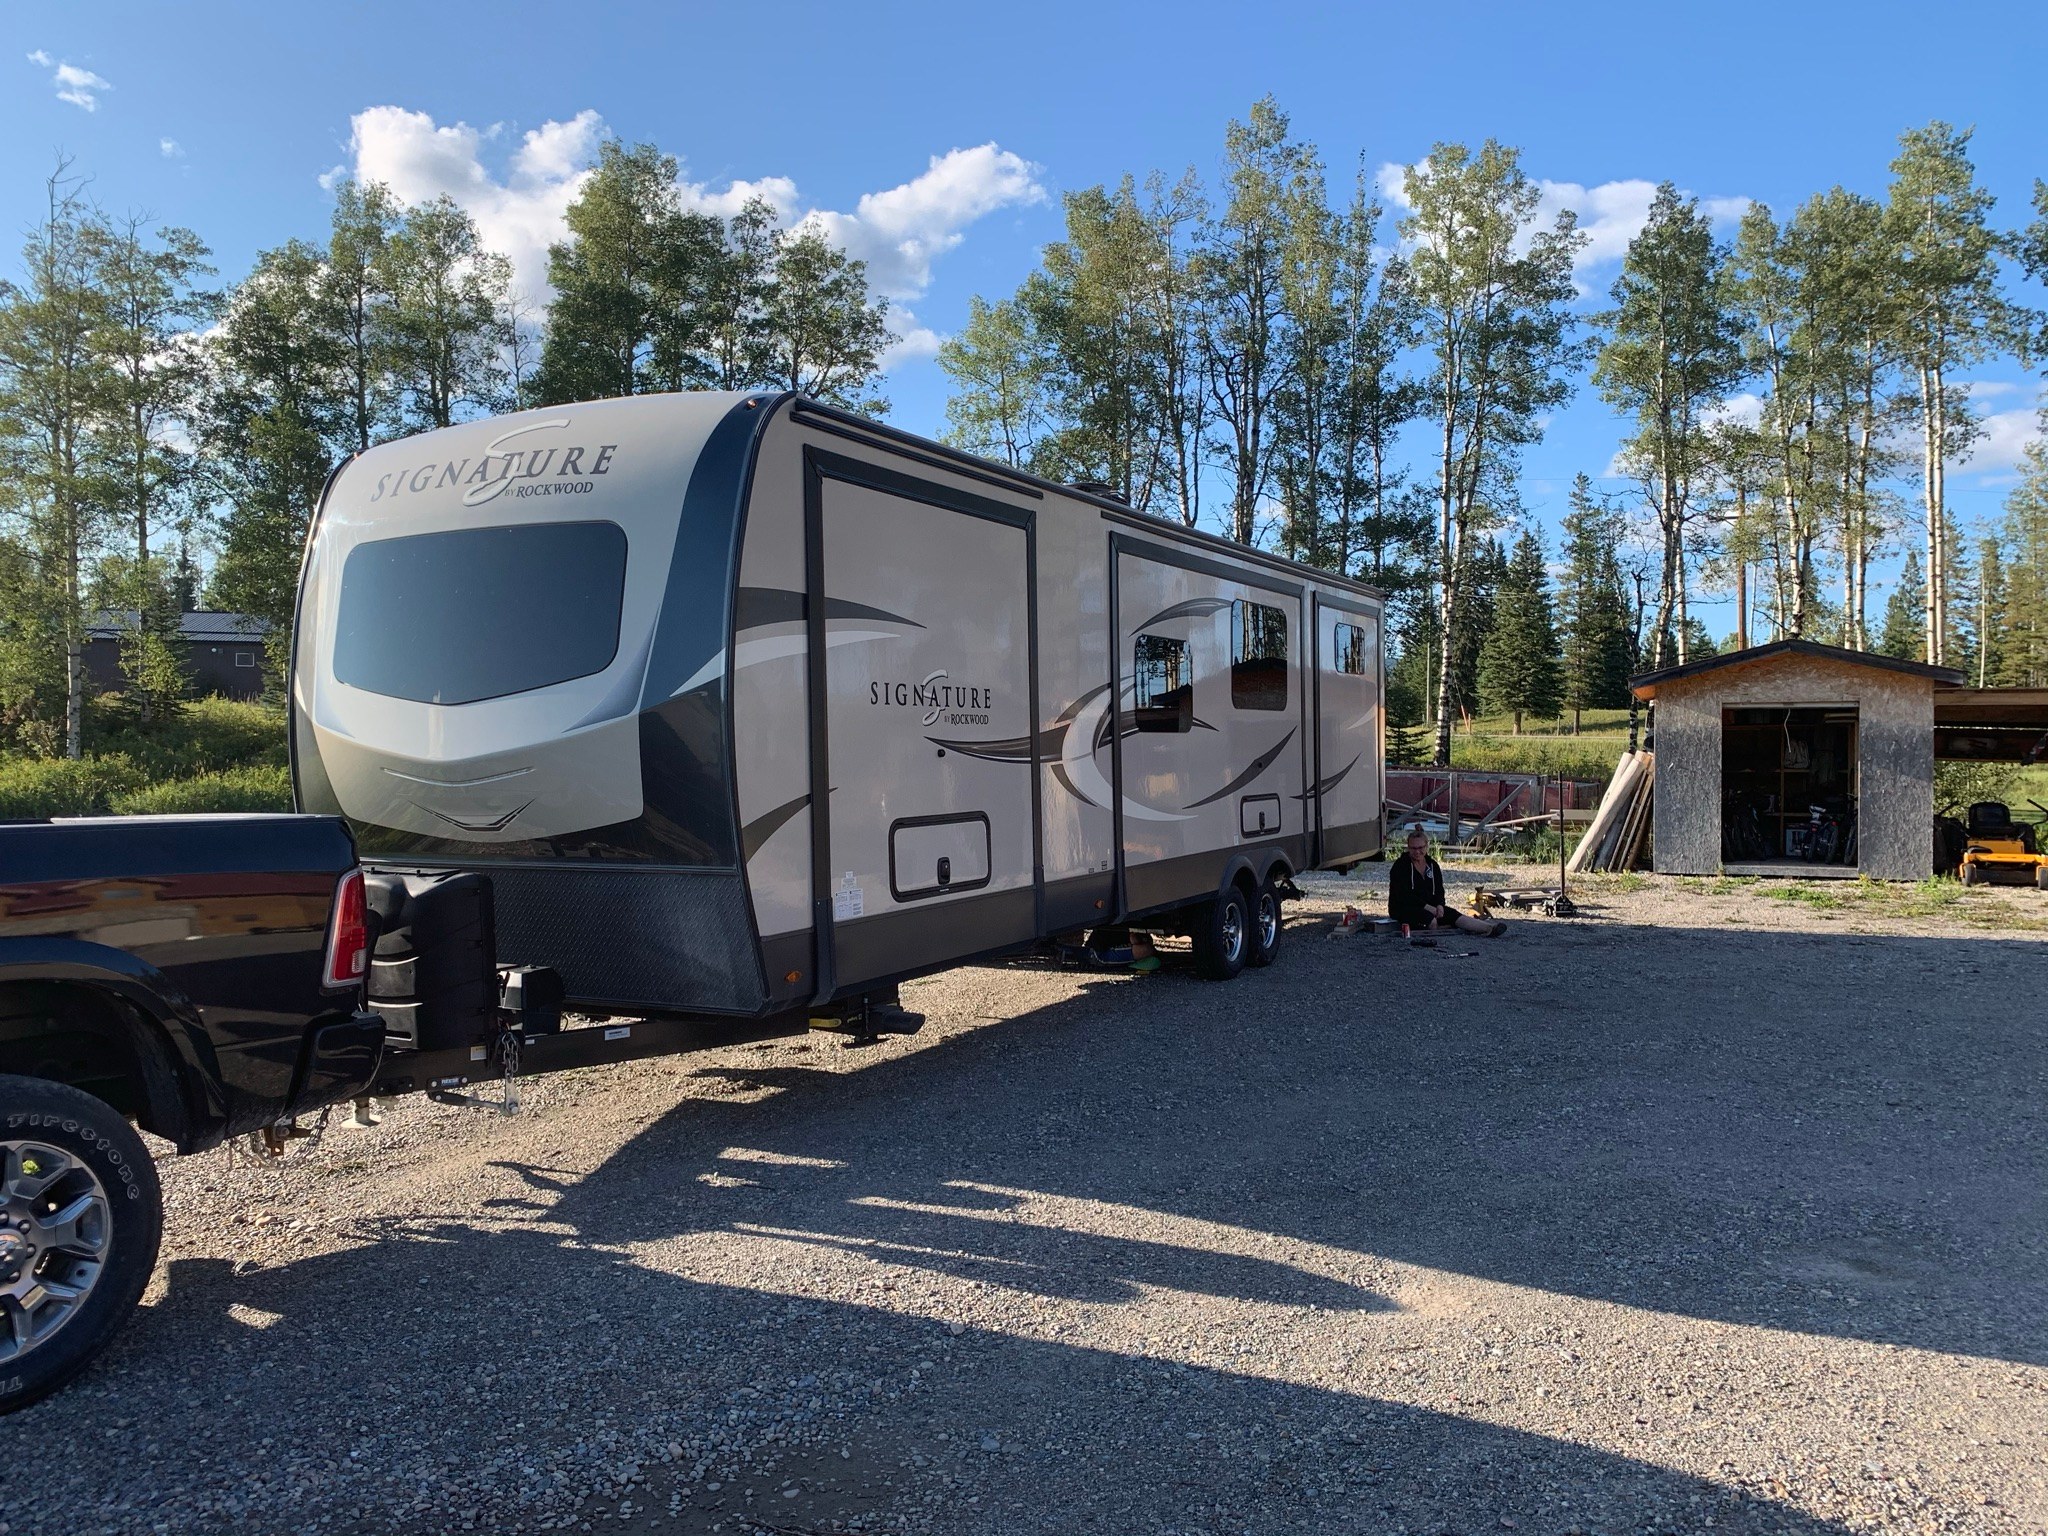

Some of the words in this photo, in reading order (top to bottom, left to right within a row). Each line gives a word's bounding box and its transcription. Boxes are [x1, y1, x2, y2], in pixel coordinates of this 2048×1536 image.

[371, 445, 618, 502] SIGNATURE
[515, 481, 594, 498] ROCKWOOD
[870, 681, 991, 709] SIGNATURE
[950, 713, 989, 726] ROCKWOOD
